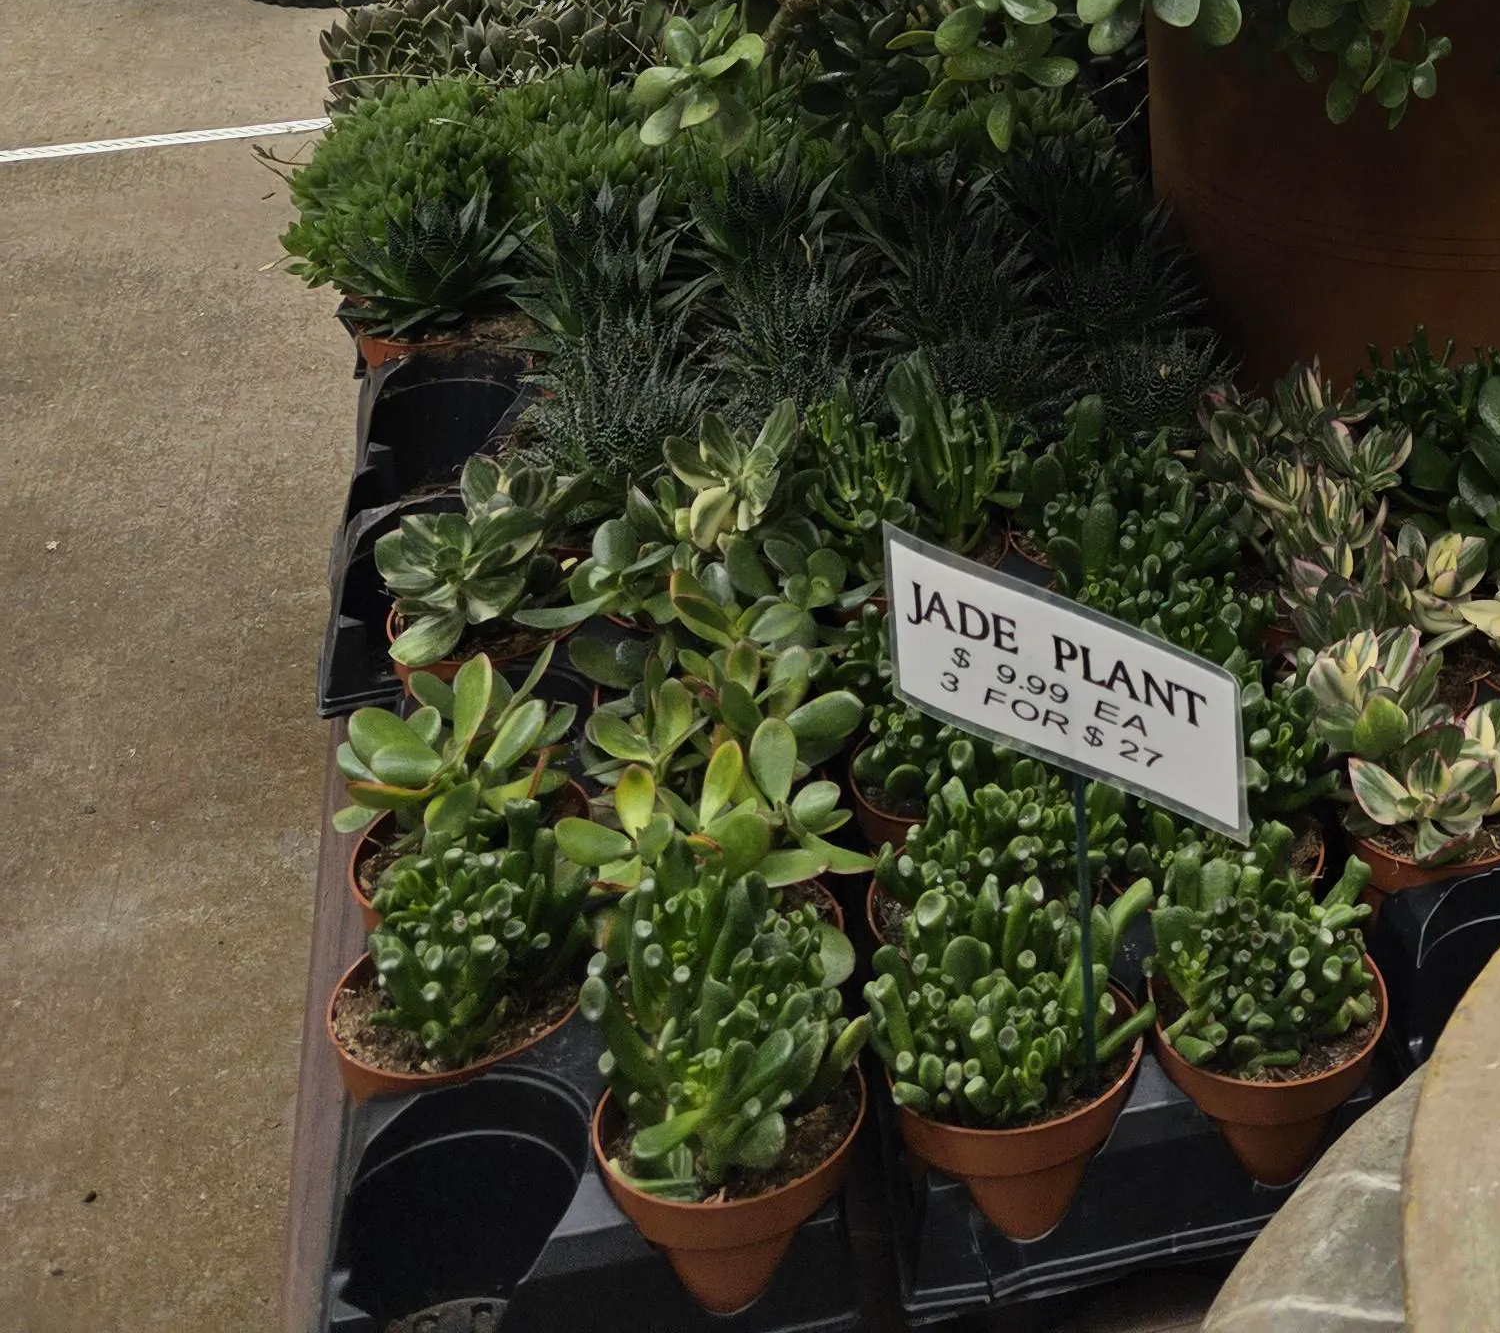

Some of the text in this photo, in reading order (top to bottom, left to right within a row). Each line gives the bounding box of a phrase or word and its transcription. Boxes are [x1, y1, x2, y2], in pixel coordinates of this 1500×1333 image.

[907, 580, 1208, 727] JADE PLANT
[951, 646, 1148, 736] $ 9.99 EA
[940, 672, 1164, 768] 3 FOR $ 27
